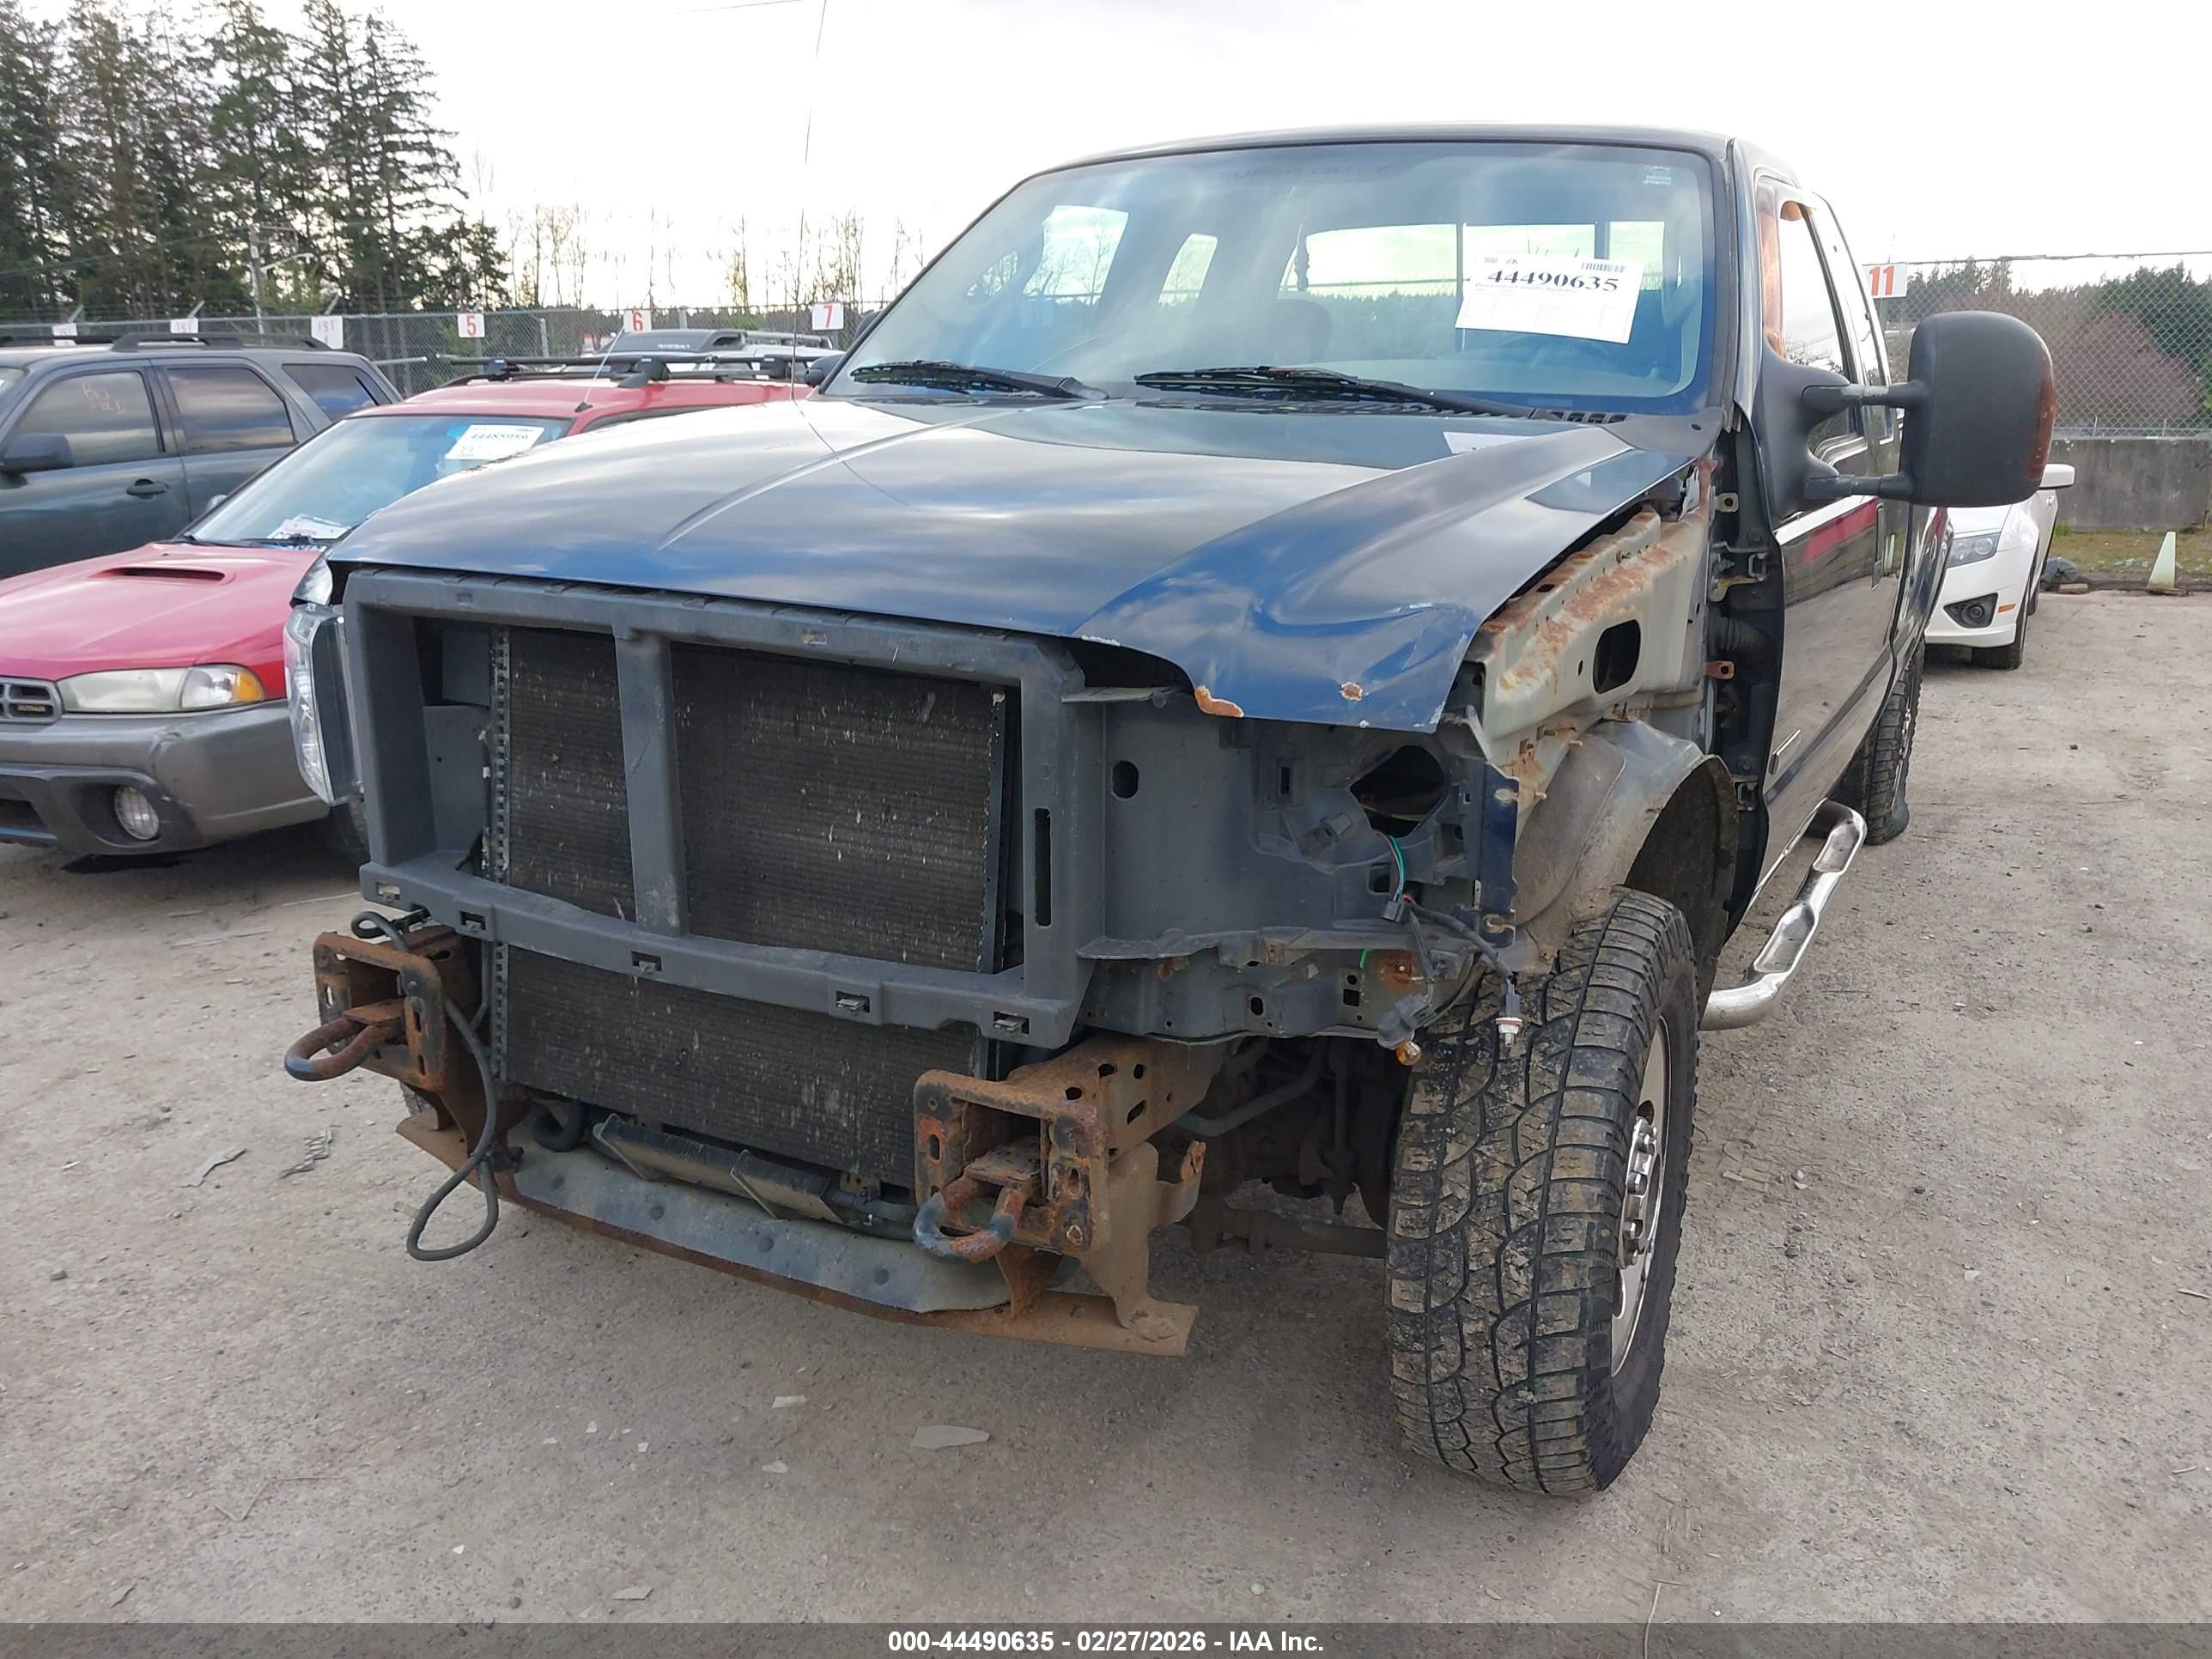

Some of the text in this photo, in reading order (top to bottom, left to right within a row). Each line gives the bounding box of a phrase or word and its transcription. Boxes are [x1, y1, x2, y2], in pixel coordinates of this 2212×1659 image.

[1487, 270, 1620, 293] 44490635
[1869, 265, 1894, 296] 11
[466, 313, 477, 333] 5
[633, 311, 644, 331] 6
[822, 306, 836, 329] 7
